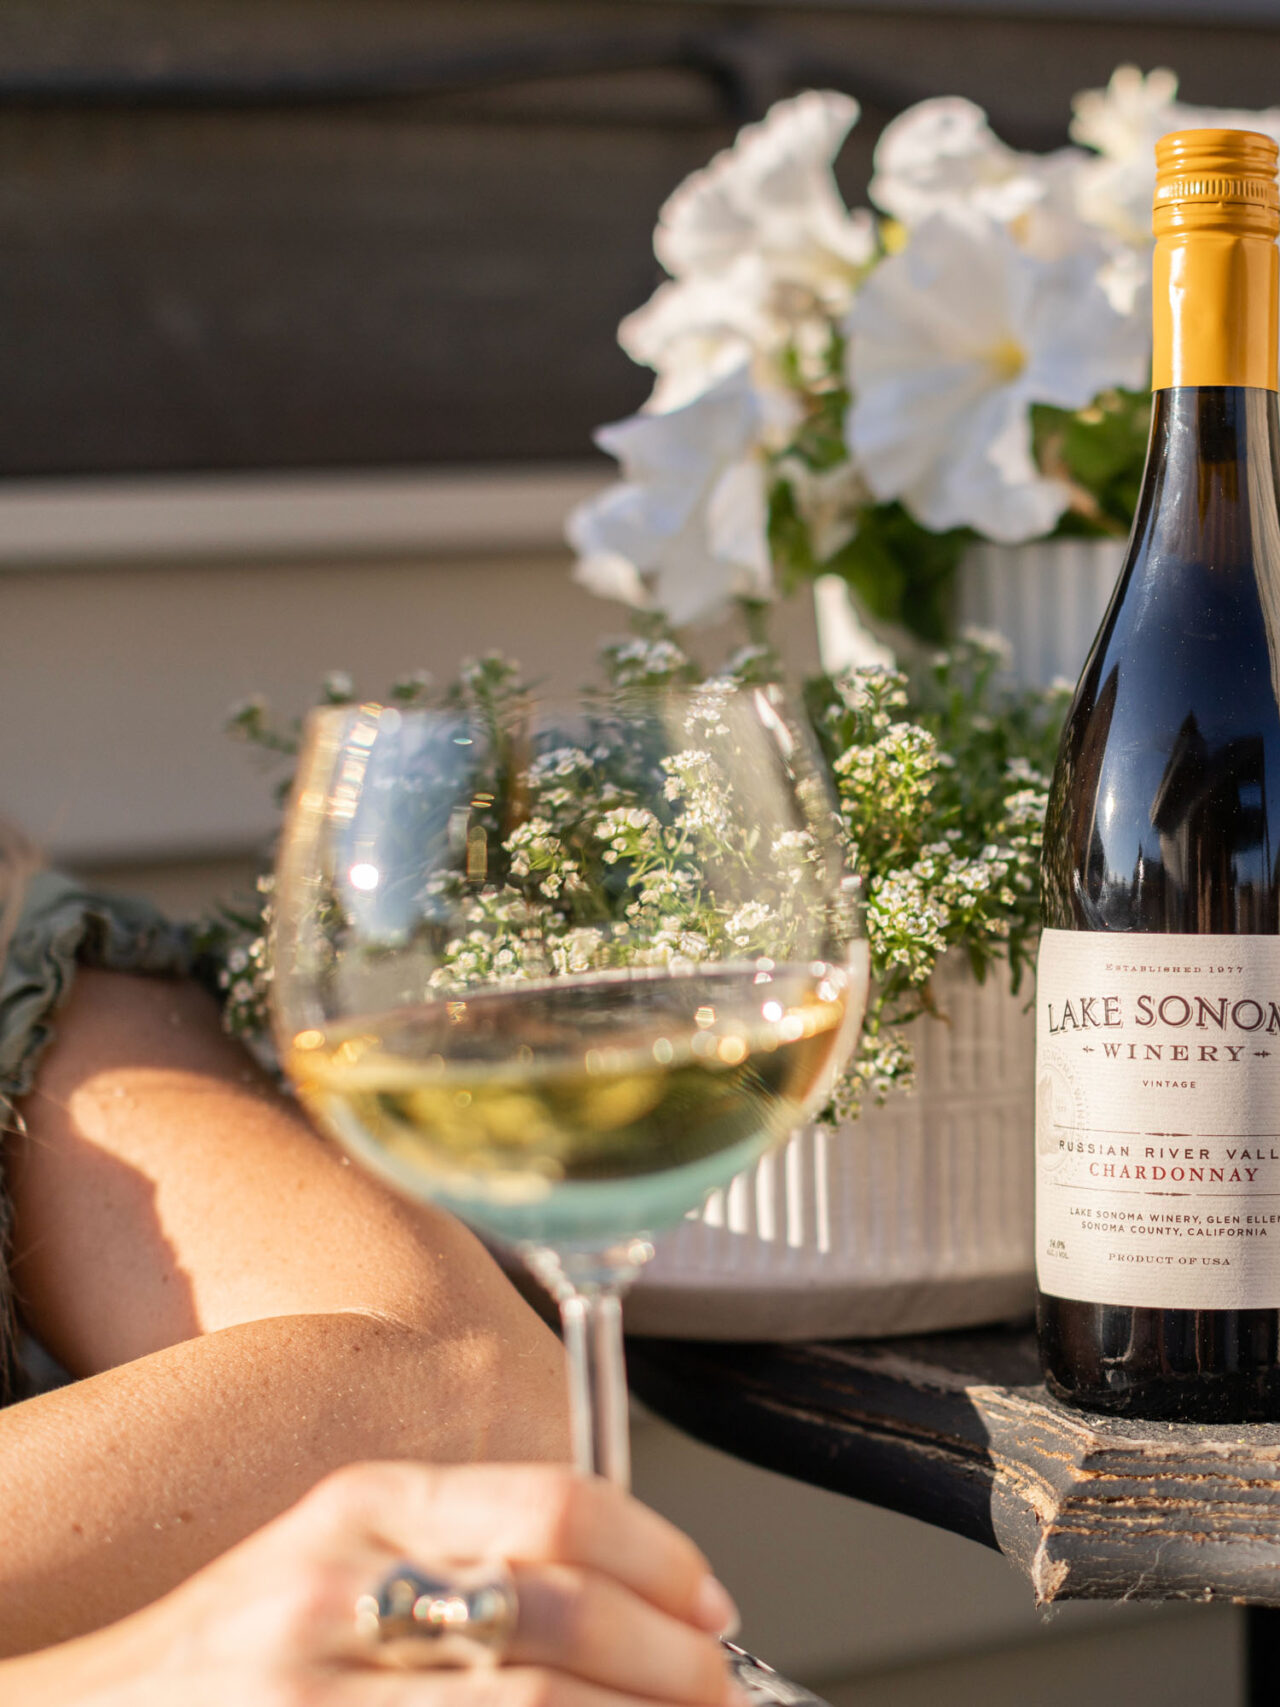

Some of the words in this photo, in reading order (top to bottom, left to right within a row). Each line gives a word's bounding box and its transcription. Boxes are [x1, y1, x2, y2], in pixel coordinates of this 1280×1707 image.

[1209, 966, 1243, 974] 1977
[1048, 995, 1124, 1035] LAKE
[1103, 1043, 1246, 1062] WINERY
[1143, 1080, 1196, 1089] VINTAGE
[1059, 1140, 1130, 1157] RUSSIAN
[1145, 1147, 1210, 1160] RIVER
[1089, 1162, 1259, 1182] CHARDONNAY
[1070, 1207, 1092, 1217] LAKE
[1096, 1210, 1144, 1221] SONOMA
[1149, 1214, 1202, 1224] WINERY,
[1206, 1215, 1241, 1224] GLEN
[1081, 1220, 1125, 1233] SONOMA
[1130, 1225, 1183, 1237] COUNTY,
[1187, 1228, 1268, 1237] CALIFORNIA
[1109, 1253, 1174, 1265] PRODUCT
[1178, 1256, 1198, 1265] OF
[1202, 1257, 1231, 1266] USA
